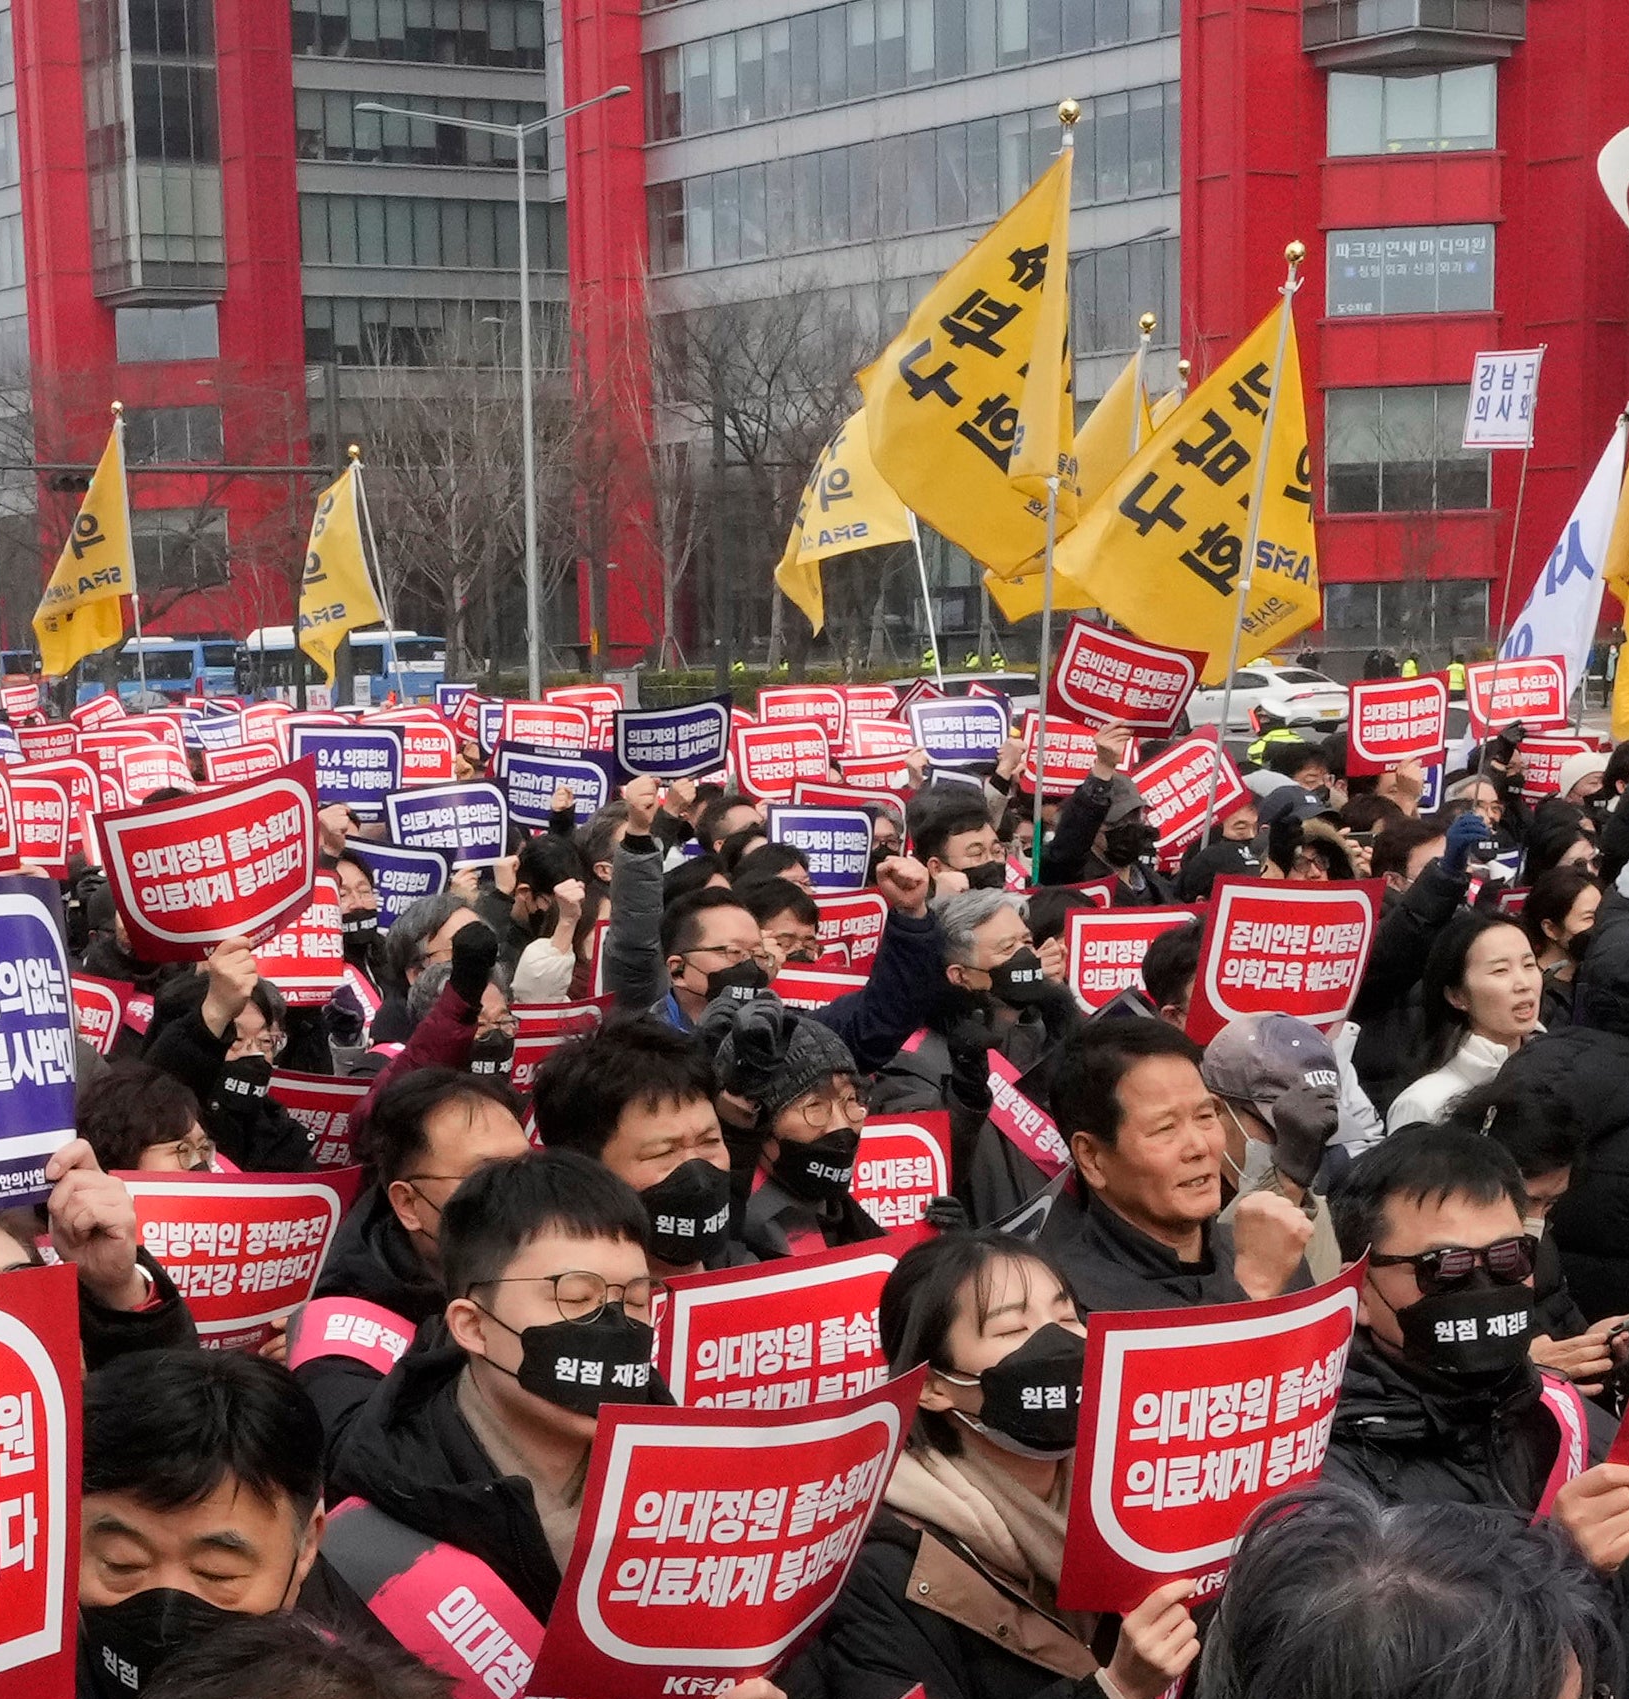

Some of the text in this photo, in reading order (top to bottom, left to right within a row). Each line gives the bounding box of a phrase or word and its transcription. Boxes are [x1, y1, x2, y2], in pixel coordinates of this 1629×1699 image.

[1479, 363, 1535, 391] 강남구
[1474, 393, 1531, 422] 의사회
[1075, 647, 1186, 692] 준비안된 의대증원
[1068, 670, 1176, 711] 의학교육 훼손된다
[318, 748, 390, 768] 9.4 의정합의
[352, 770, 393, 790] 이행하라
[400, 806, 456, 832] 의료계와
[132, 806, 302, 879] 의대정원 졸속확대
[140, 846, 304, 914] 의료체계 붕괴된다
[1083, 939, 1148, 965] 의대정원
[1229, 920, 1363, 955] 준비안된 의대증원
[1221, 958, 1355, 993] 의학교육 훼손된다
[857, 1155, 935, 1192] 의대증원
[142, 1213, 326, 1259] 일방적인 정책추진
[655, 1212, 697, 1239] 원점
[241, 1252, 320, 1295] 위협한다
[1434, 1310, 1529, 1344] 원점 재검토
[694, 1321, 815, 1384] 의대정원
[553, 1356, 604, 1387] 원점
[1020, 1384, 1067, 1411] 원점
[1127, 1375, 1277, 1447] 의대정원
[1121, 1443, 1265, 1514] 의료체계
[628, 1447, 883, 1548] 의대정원 졸속확대
[608, 1554, 774, 1610] 의료체계
